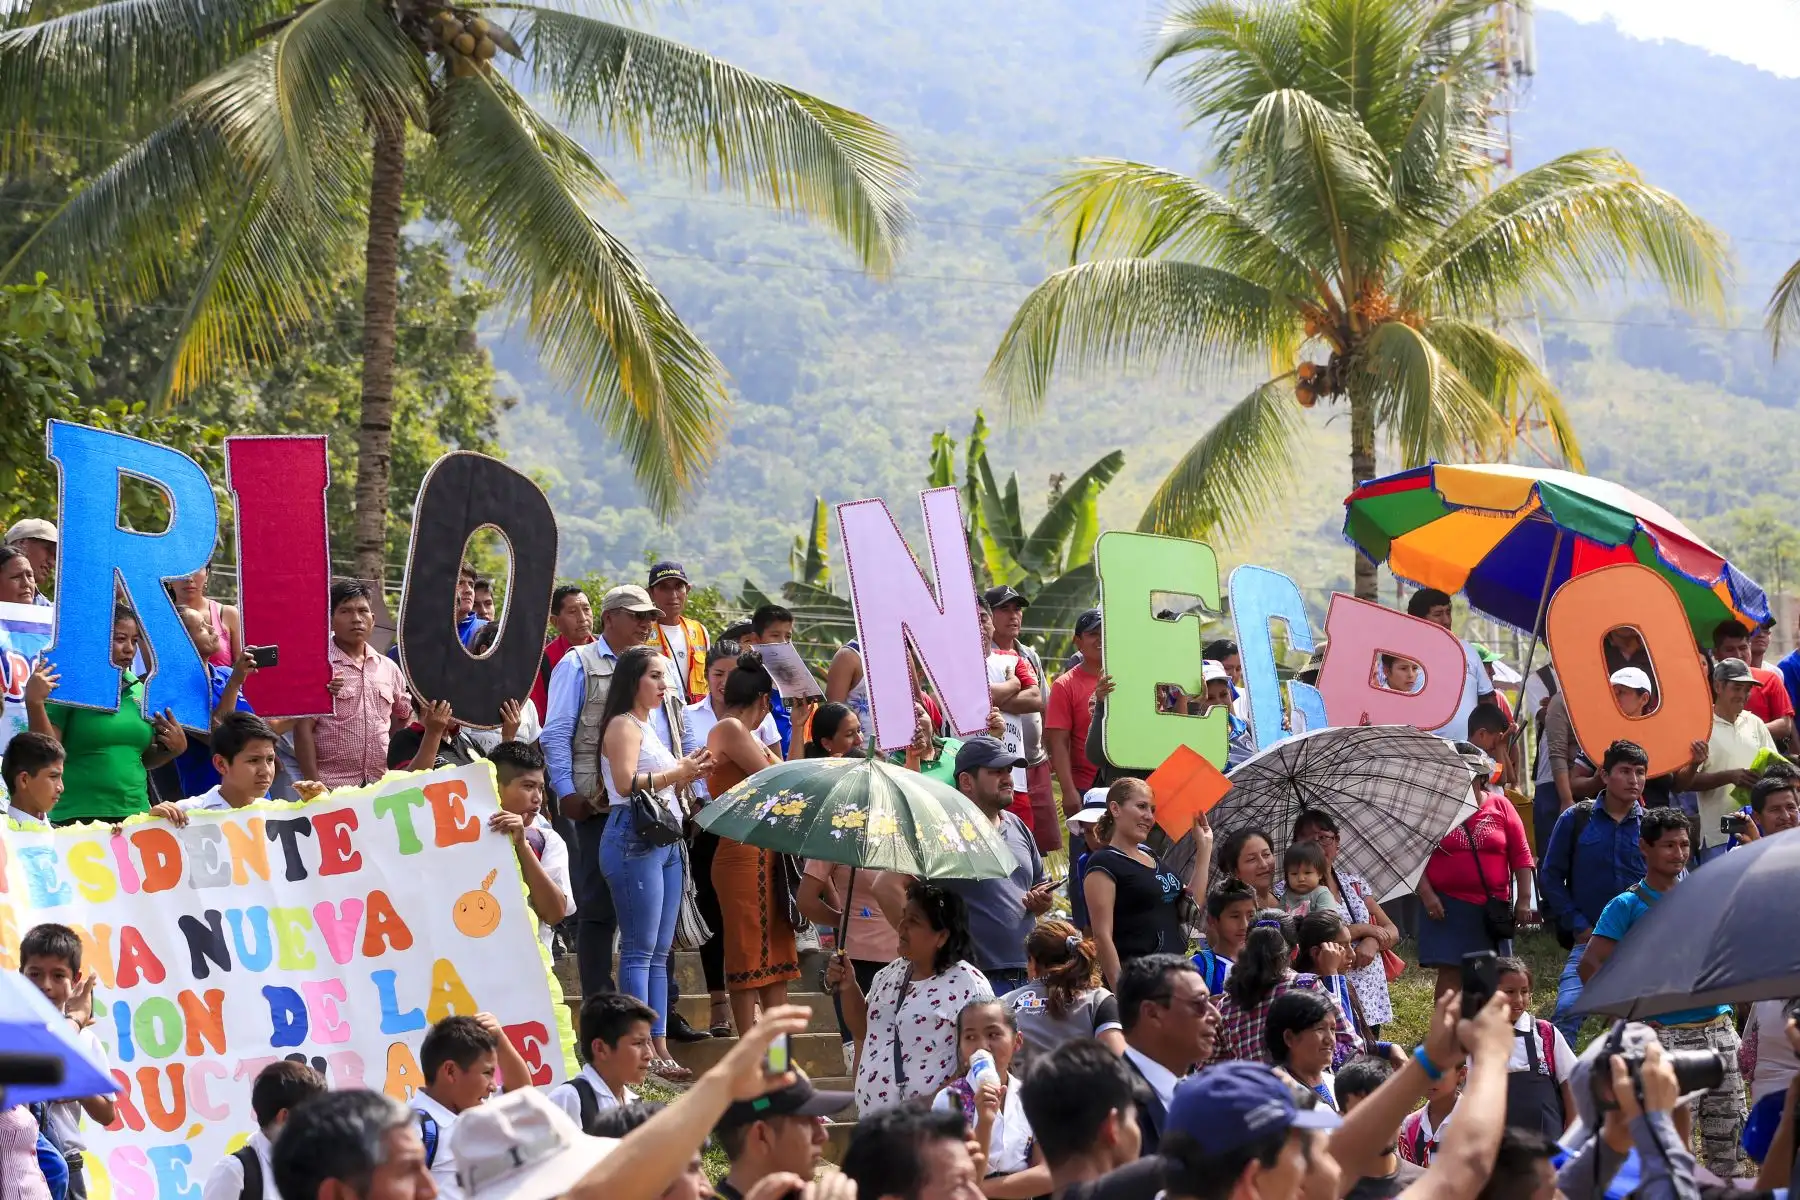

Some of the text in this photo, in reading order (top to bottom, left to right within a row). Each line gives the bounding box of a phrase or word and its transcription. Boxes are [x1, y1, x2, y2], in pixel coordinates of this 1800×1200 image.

[46, 418, 559, 733] RIO
[0, 779, 481, 908] ESIDENTE TE
[66, 923, 166, 989] NA
[178, 890, 413, 980] NUEVA
[262, 977, 351, 1048] DE
[370, 958, 478, 1035] LA
[495, 1021, 553, 1087] E
